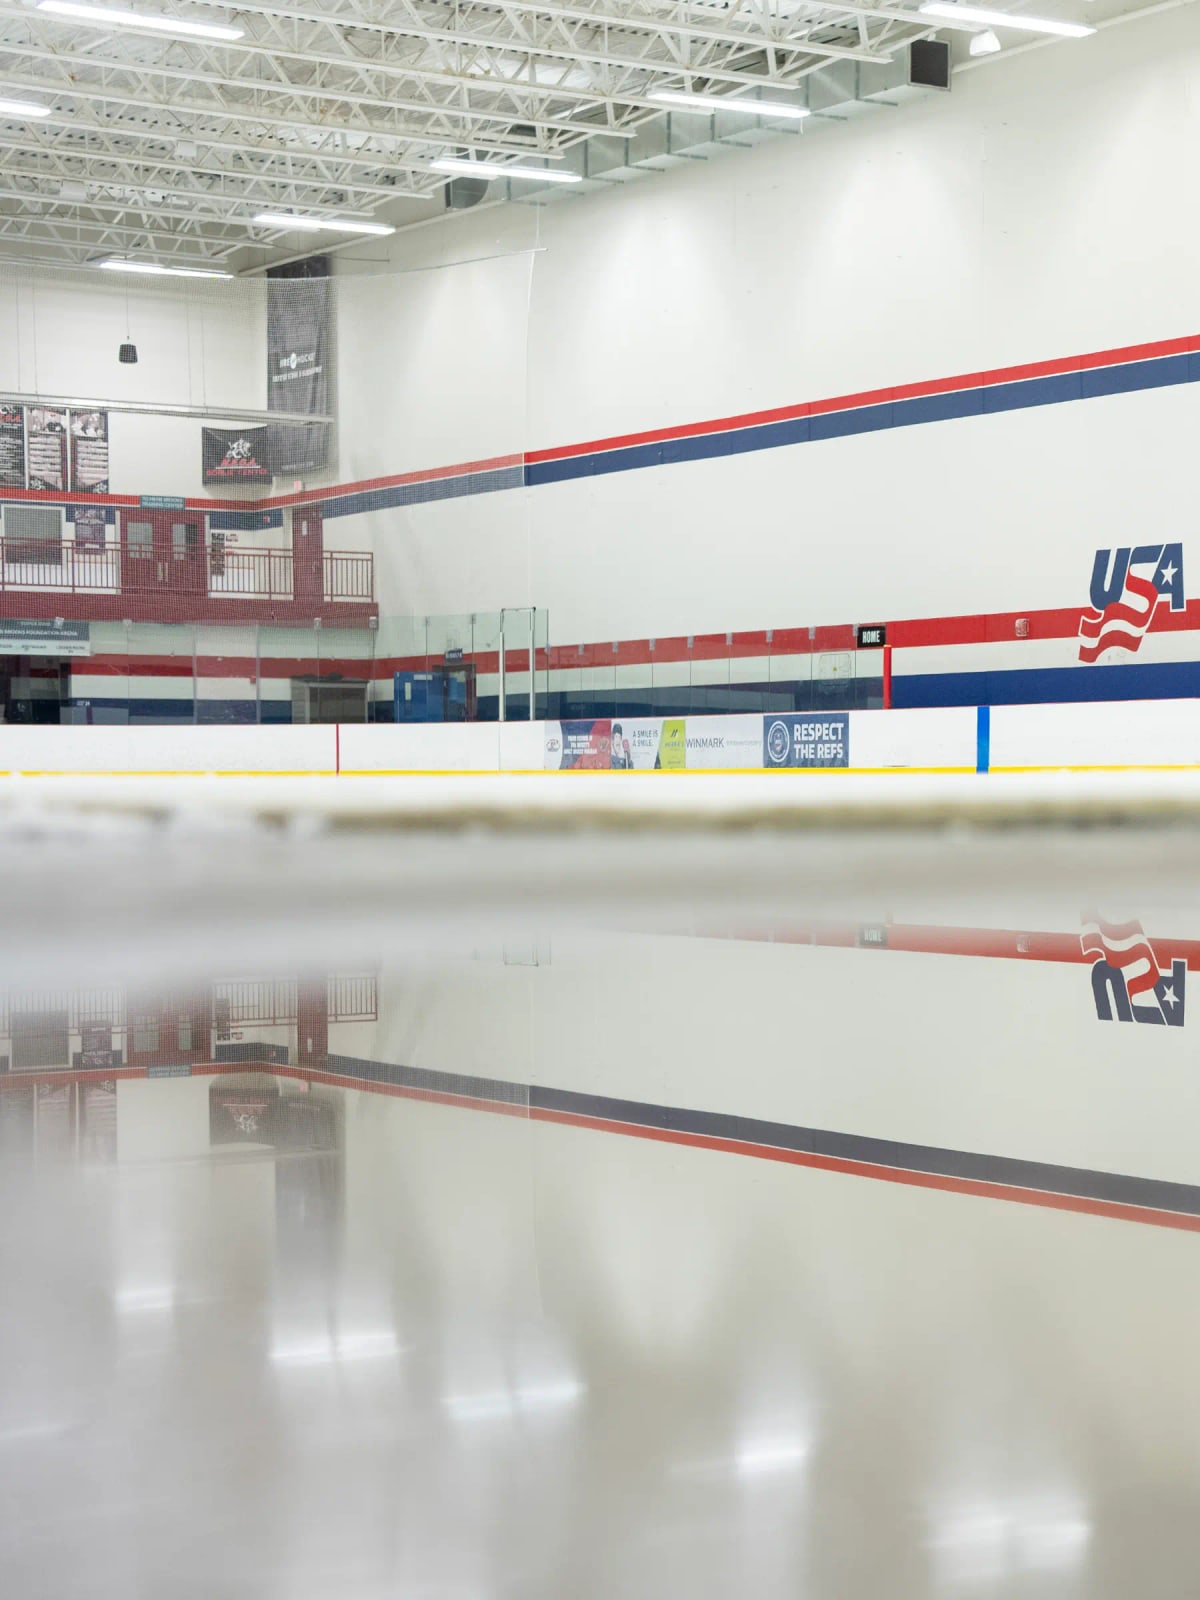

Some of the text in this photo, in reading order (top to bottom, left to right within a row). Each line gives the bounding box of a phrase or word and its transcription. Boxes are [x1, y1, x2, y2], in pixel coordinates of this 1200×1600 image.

[1078, 542, 1186, 655] USA
[863, 630, 880, 643] HOME
[794, 723, 844, 741] RESPECT
[686, 737, 724, 748] WINMARK
[794, 744, 843, 759] THE REFS
